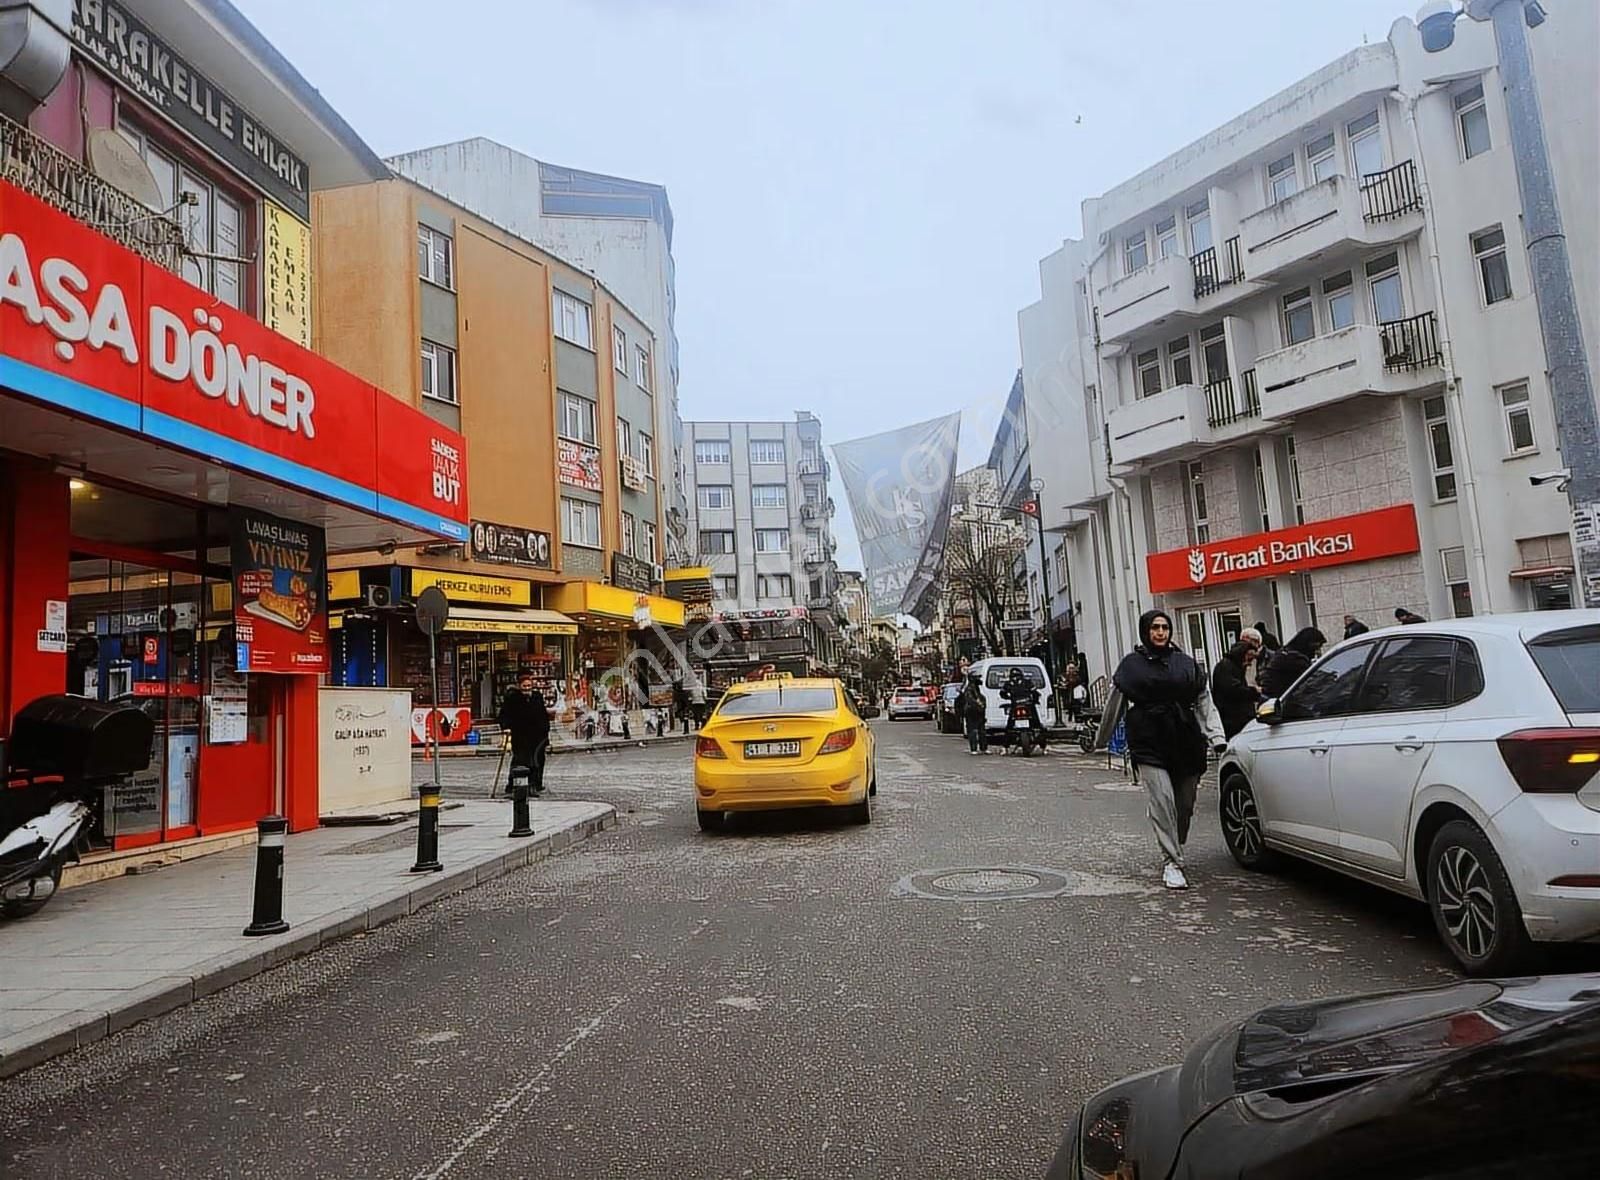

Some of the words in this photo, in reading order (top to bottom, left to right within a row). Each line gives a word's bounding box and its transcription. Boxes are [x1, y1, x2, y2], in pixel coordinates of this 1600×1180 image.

[72, 0, 234, 140] ARAKELLE
[242, 118, 303, 193] EMLAK
[283, 246, 296, 316] EMLAK
[149, 307, 316, 440] DÖNER
[433, 471, 461, 506] BUT
[248, 539, 313, 573] YİYİNİZ
[1210, 544, 1268, 574] Ziraat
[1270, 532, 1354, 565] Bankası
[436, 579, 468, 593] MERKEZ
[469, 582, 512, 598] KURUYEMİŞ
